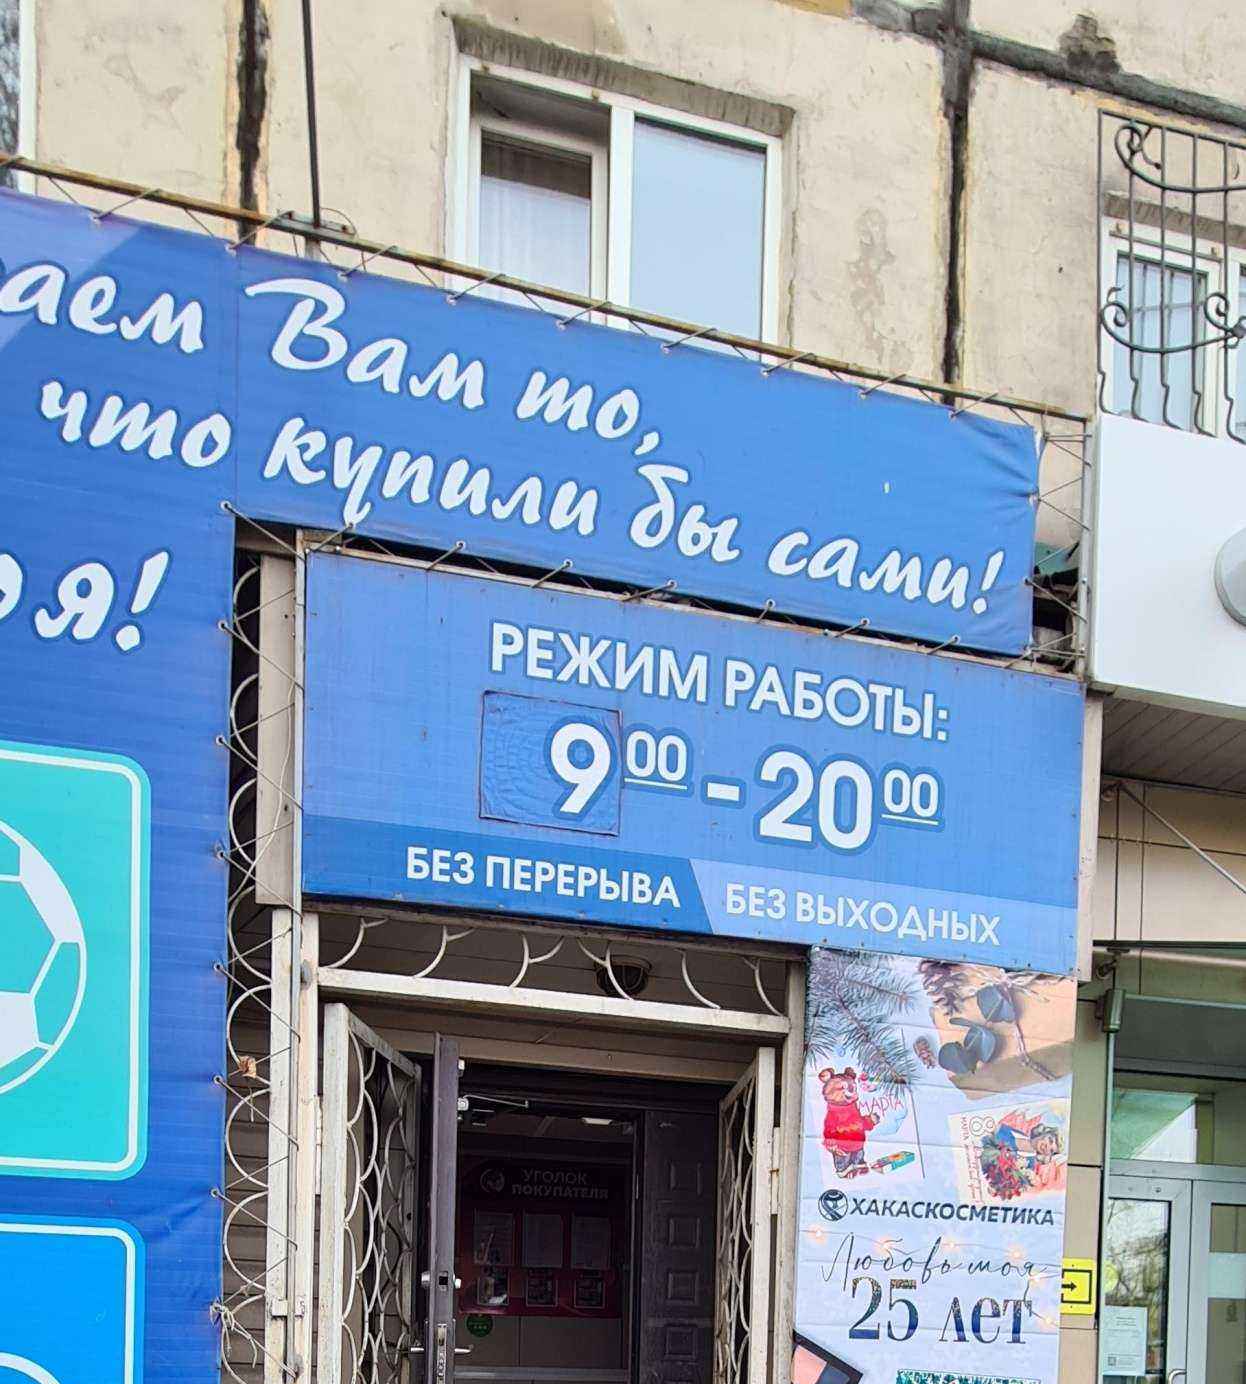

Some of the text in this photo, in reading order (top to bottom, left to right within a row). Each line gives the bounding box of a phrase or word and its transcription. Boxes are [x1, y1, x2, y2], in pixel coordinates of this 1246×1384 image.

[244, 277, 485, 410] Вам
[516, 371, 660, 456] то,
[40, 380, 1004, 615] что купили бы сами!
[490, 621, 949, 742] РЕЖИМ РАБОТЫ:
[405, 845, 682, 909] БЕЗ ПЕРЕРЫВА
[725, 882, 1002, 947] БЕЗ ВЫХОДНЫХ
[511, 1184, 609, 1199] ПОКУПАТЕЛЯ
[522, 1168, 588, 1184] УГОЛОК
[850, 1198, 1055, 1227] ХАКАСКОСМЕТИКА
[821, 1232, 1046, 1292] Любовь моя
[848, 1275, 920, 1342] 25
[938, 1295, 1034, 1345] лет
